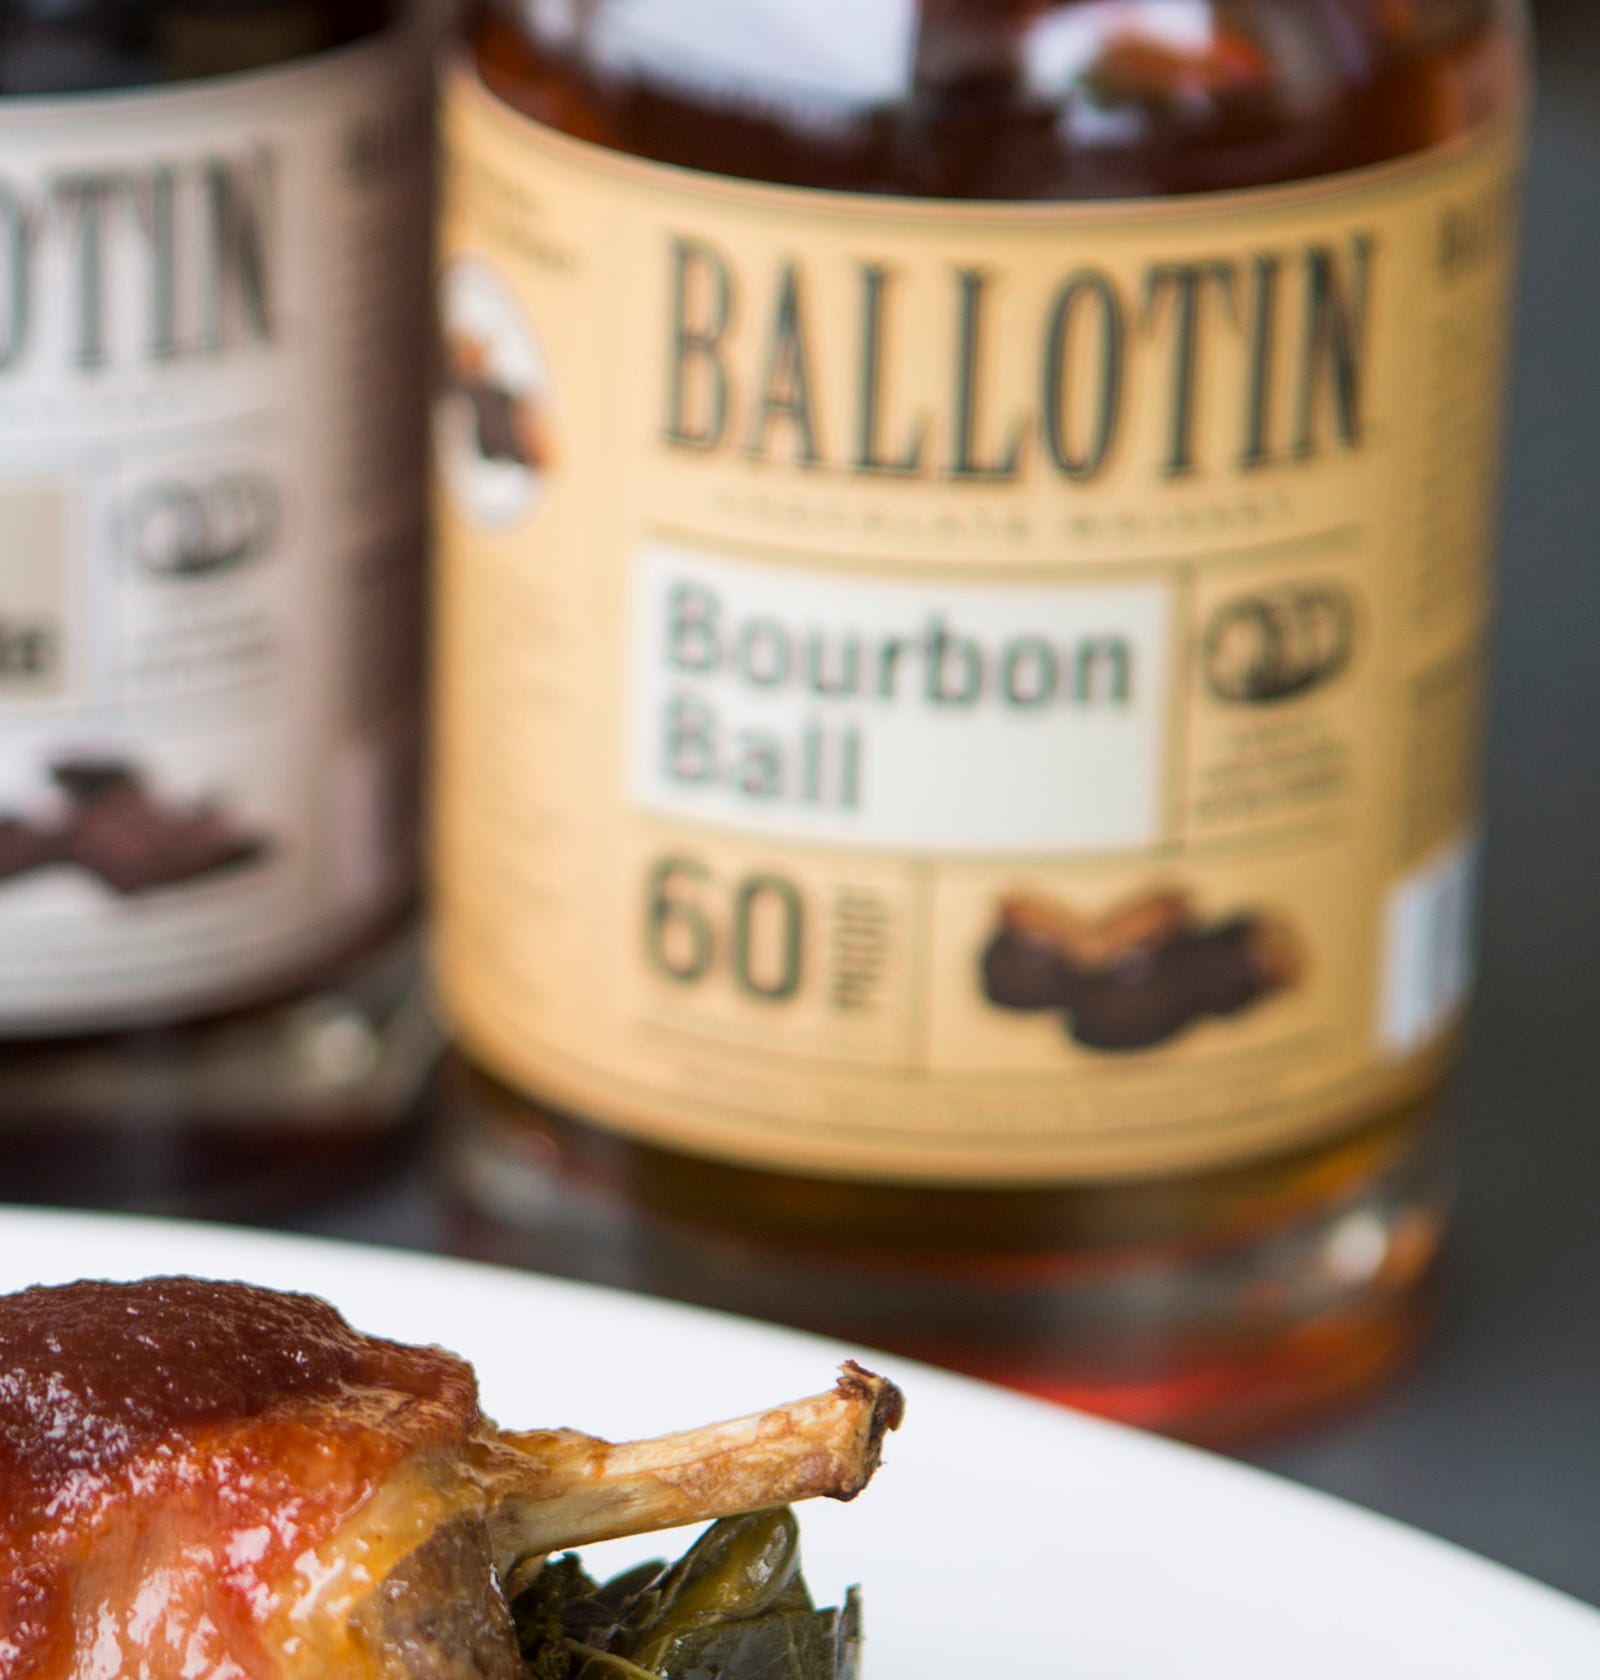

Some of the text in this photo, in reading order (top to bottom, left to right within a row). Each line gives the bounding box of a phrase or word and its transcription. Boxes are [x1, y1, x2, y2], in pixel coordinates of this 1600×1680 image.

[662, 228, 1378, 483] BALLOTIN
[667, 580, 1133, 713] Bourbon
[664, 690, 863, 811] Ball
[643, 855, 807, 1005] 60
